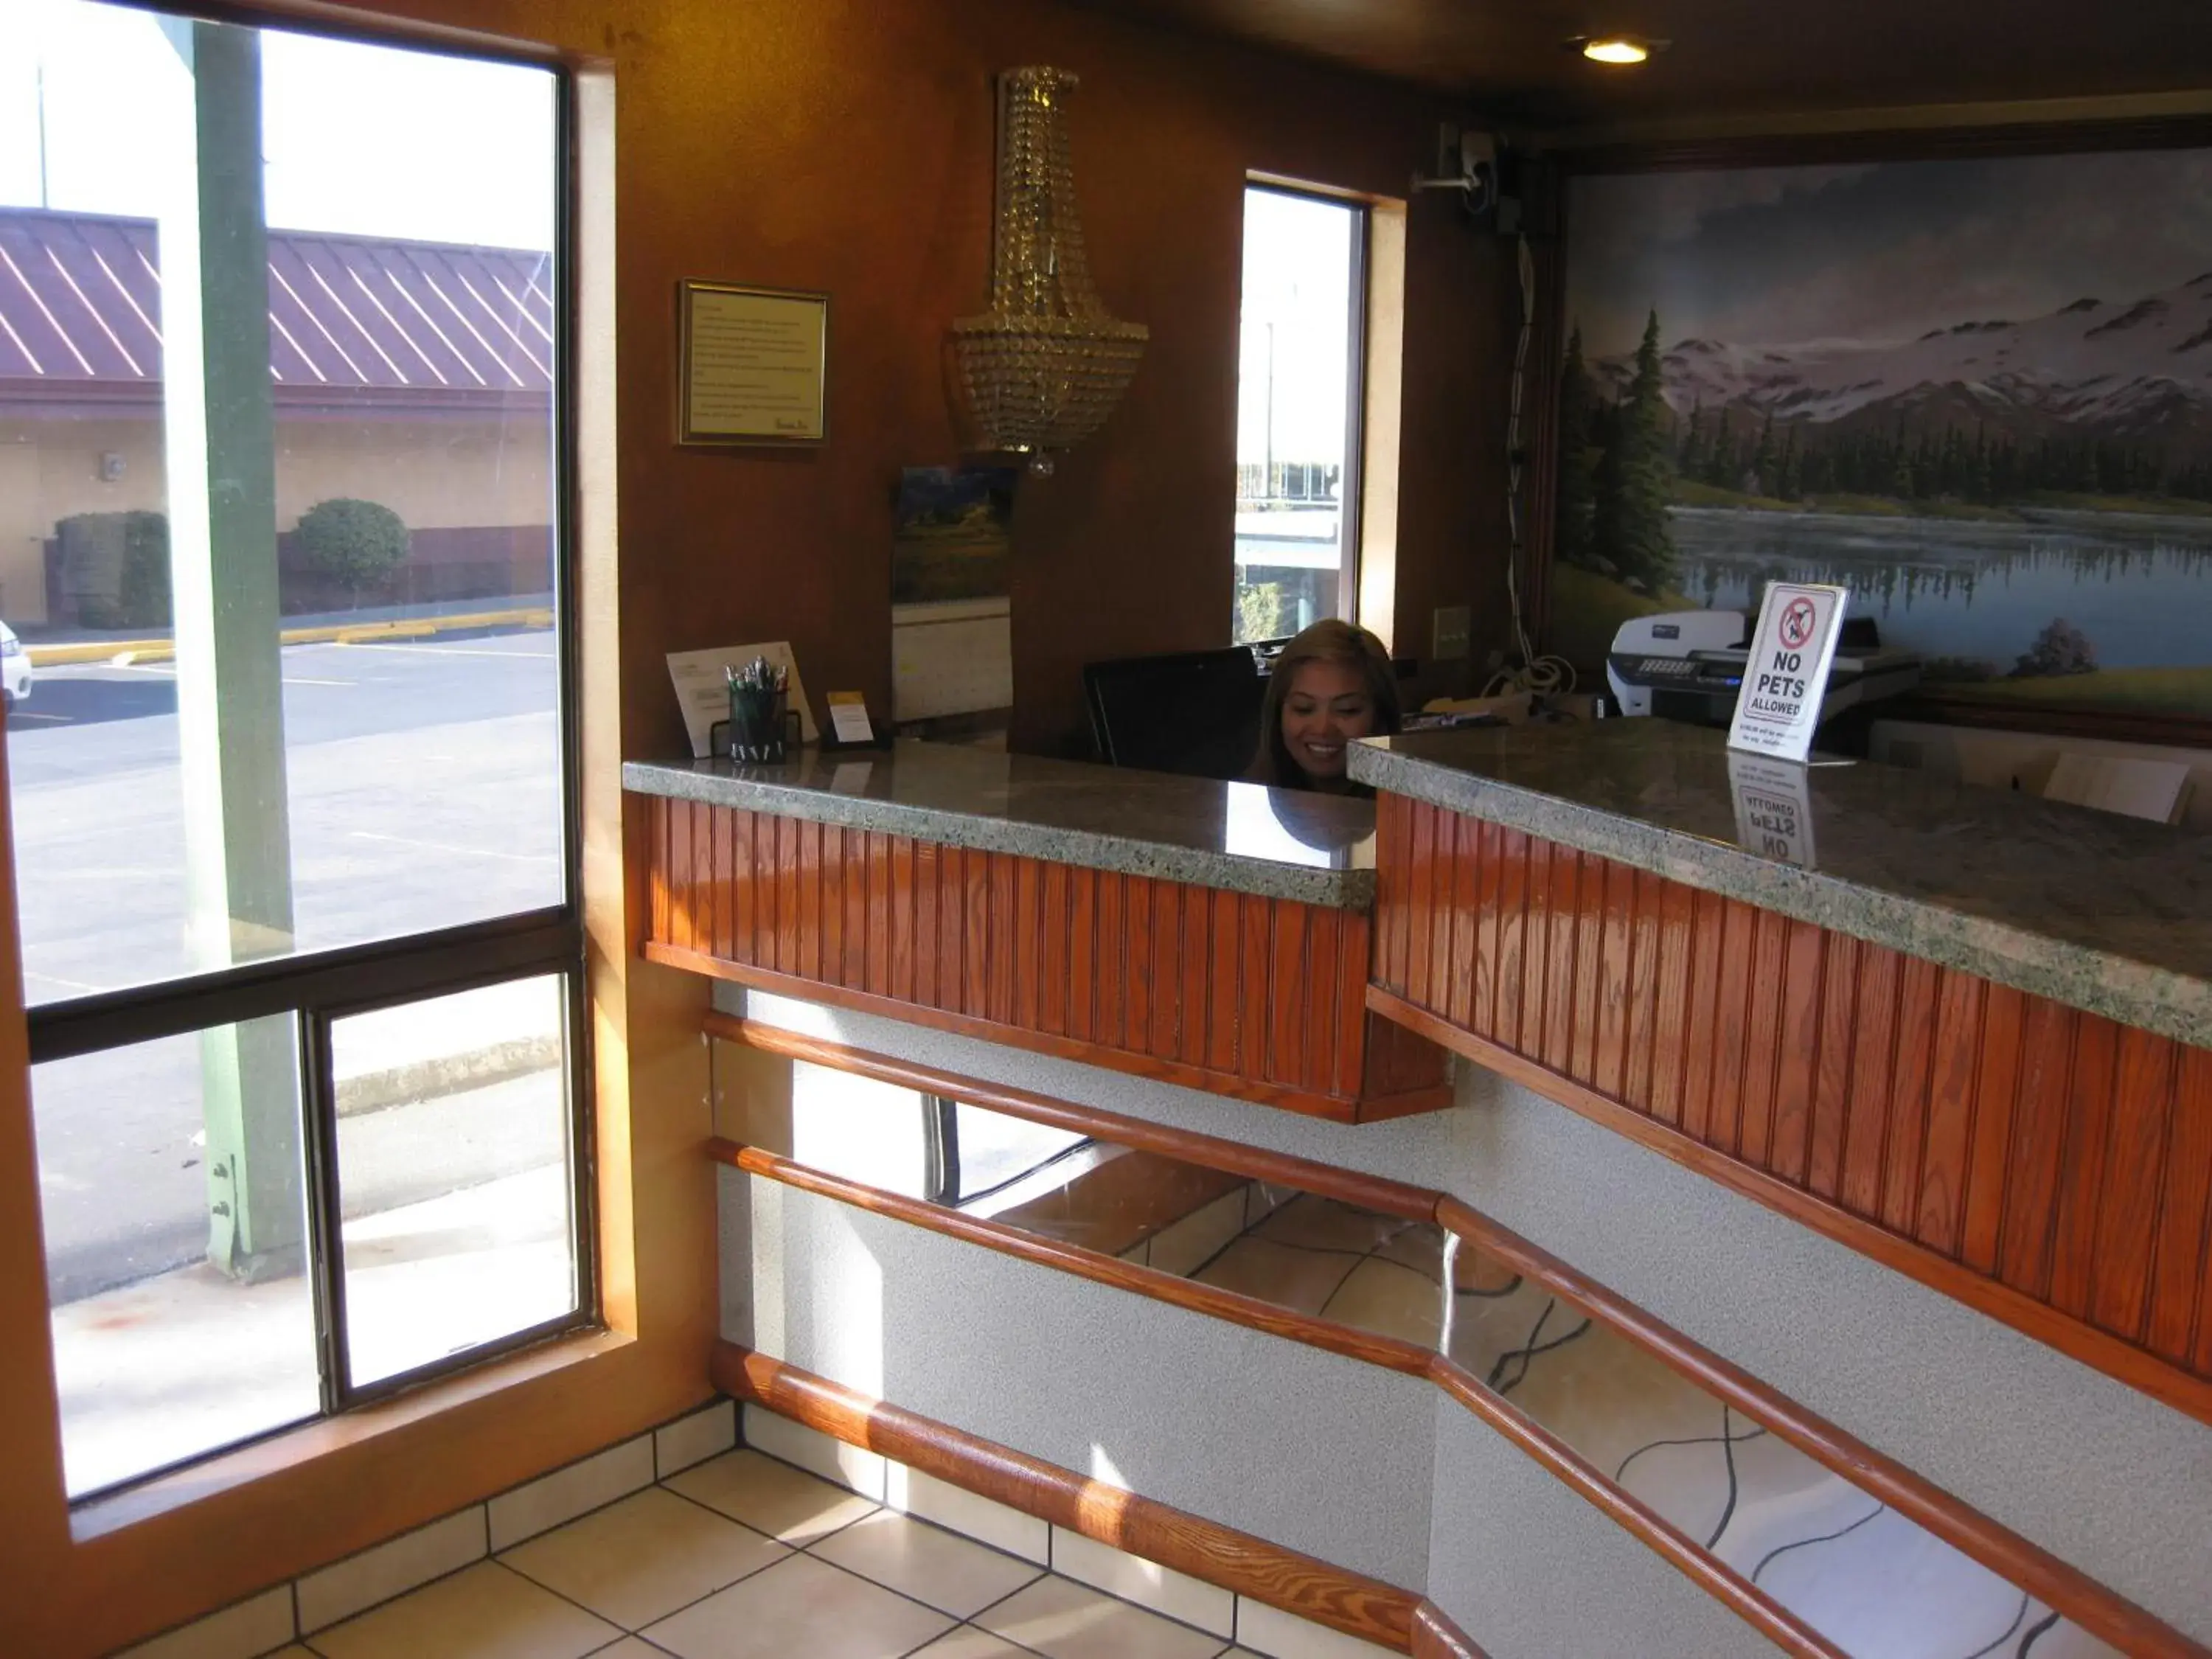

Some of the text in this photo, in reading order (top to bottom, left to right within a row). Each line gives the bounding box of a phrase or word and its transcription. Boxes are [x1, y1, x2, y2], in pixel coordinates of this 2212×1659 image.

[1773, 651, 1801, 672] NO
[1757, 673, 1805, 698] PETS
[1750, 698, 1801, 716] ALLOWED
